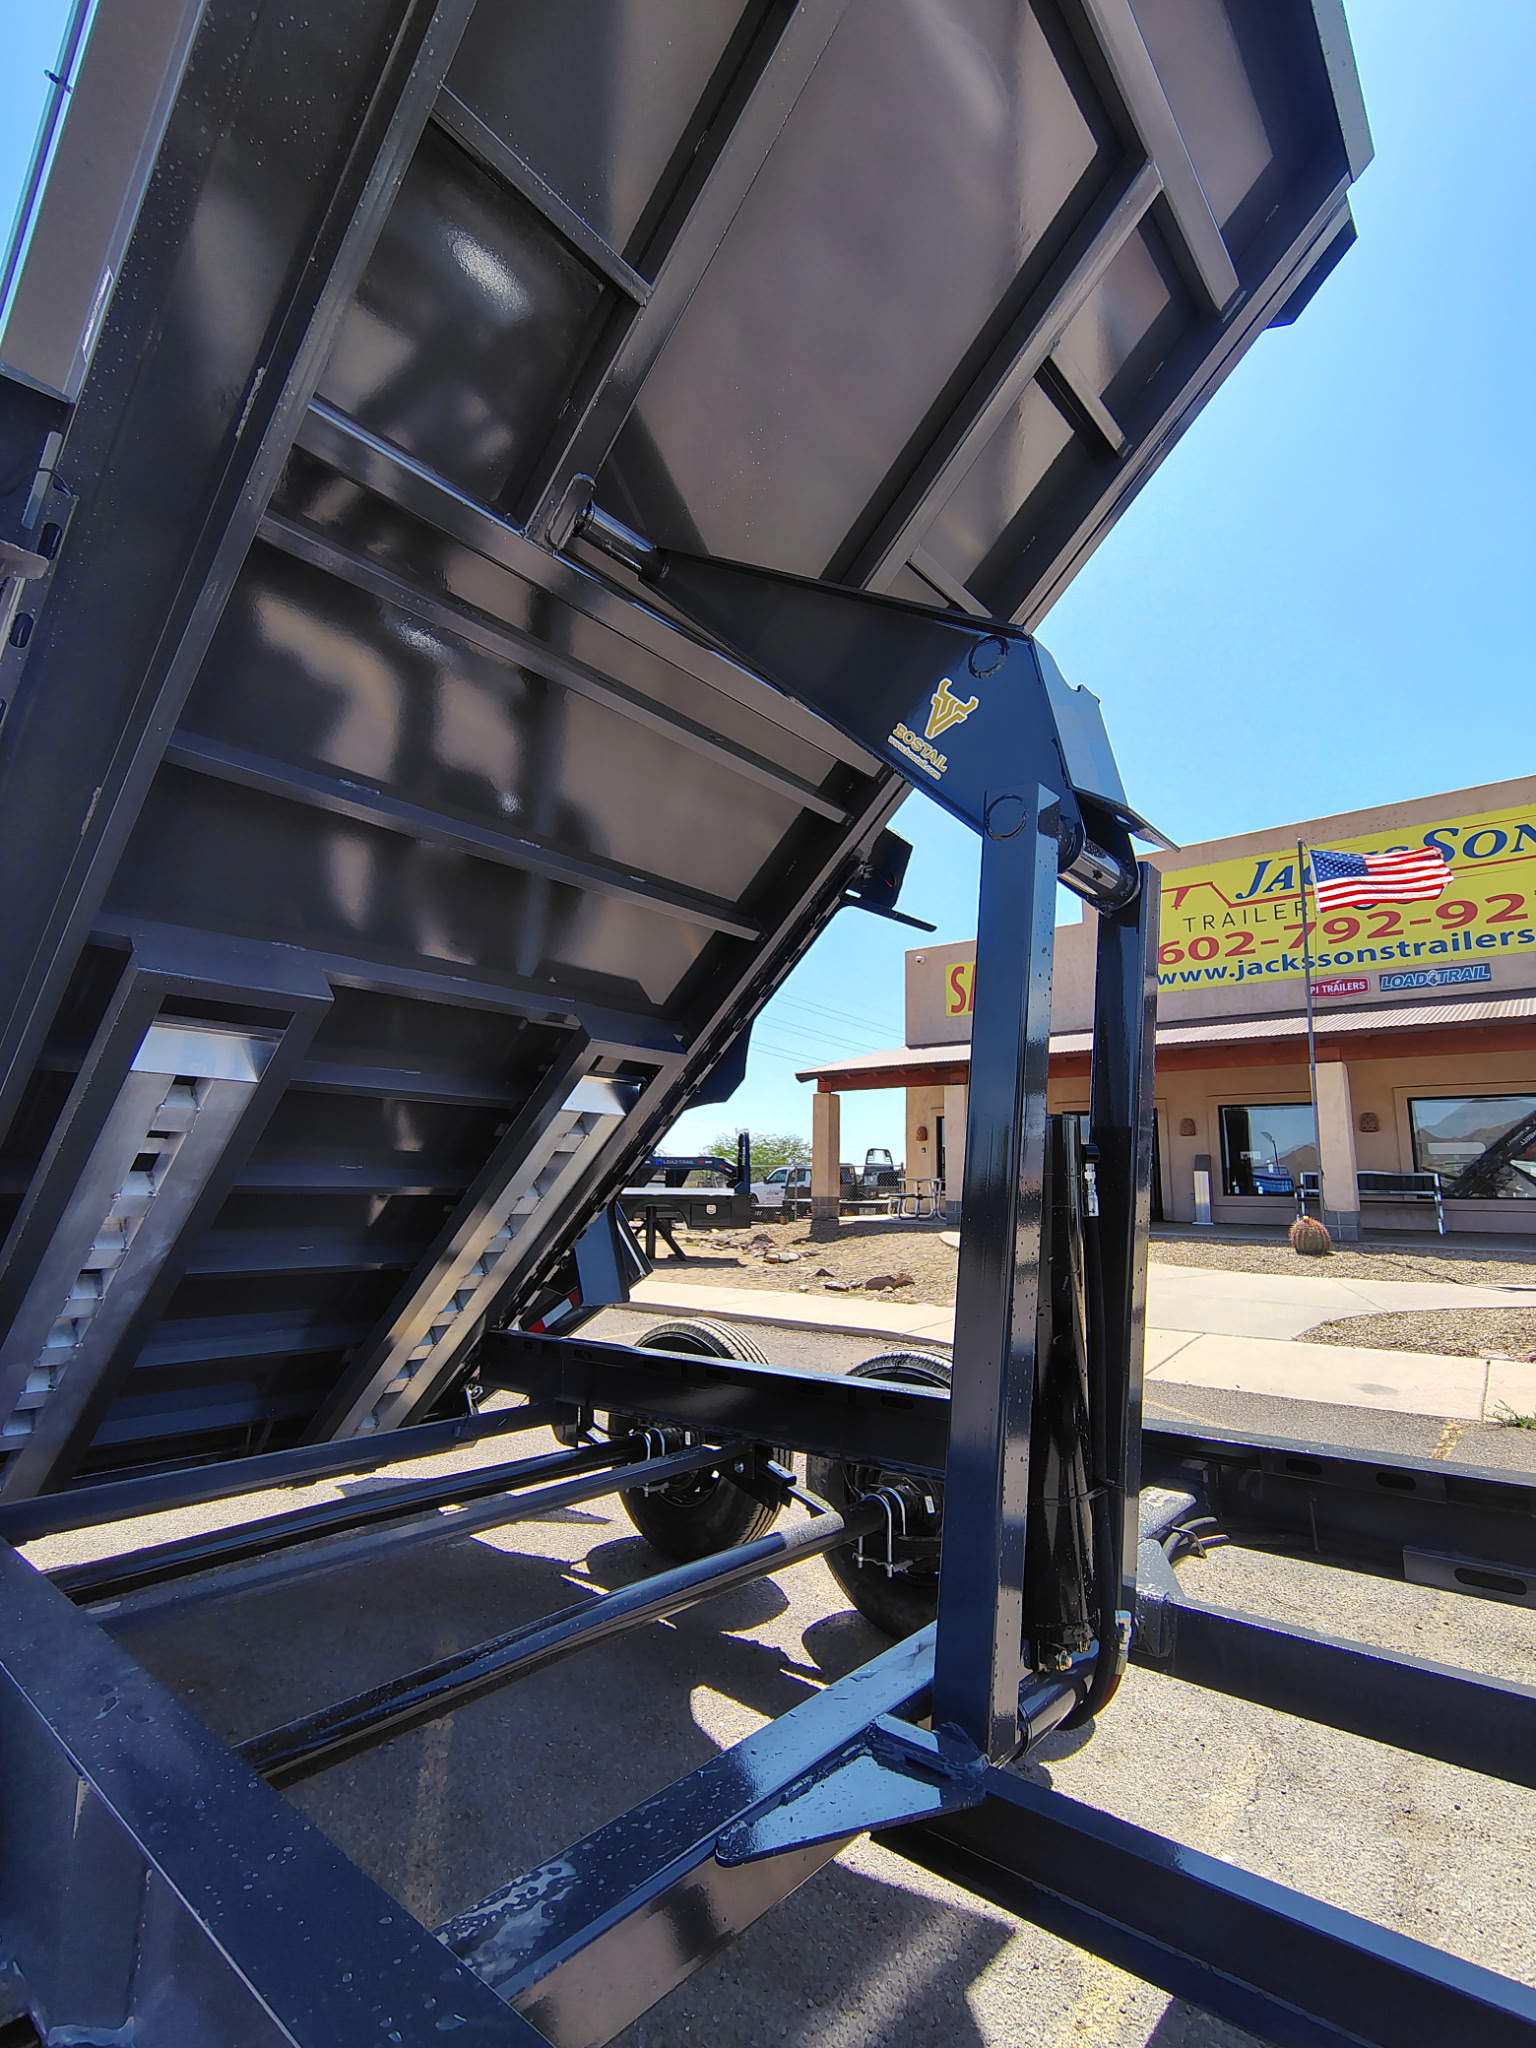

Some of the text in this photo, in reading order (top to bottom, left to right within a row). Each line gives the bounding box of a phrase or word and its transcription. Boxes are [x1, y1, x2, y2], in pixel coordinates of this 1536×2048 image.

[893, 722, 948, 773] BOSTAIL
[1157, 889, 1536, 966] 602-792-92
[1321, 981, 1366, 993] TRAILERS
[1380, 965, 1491, 991] LOAD TRAIL
